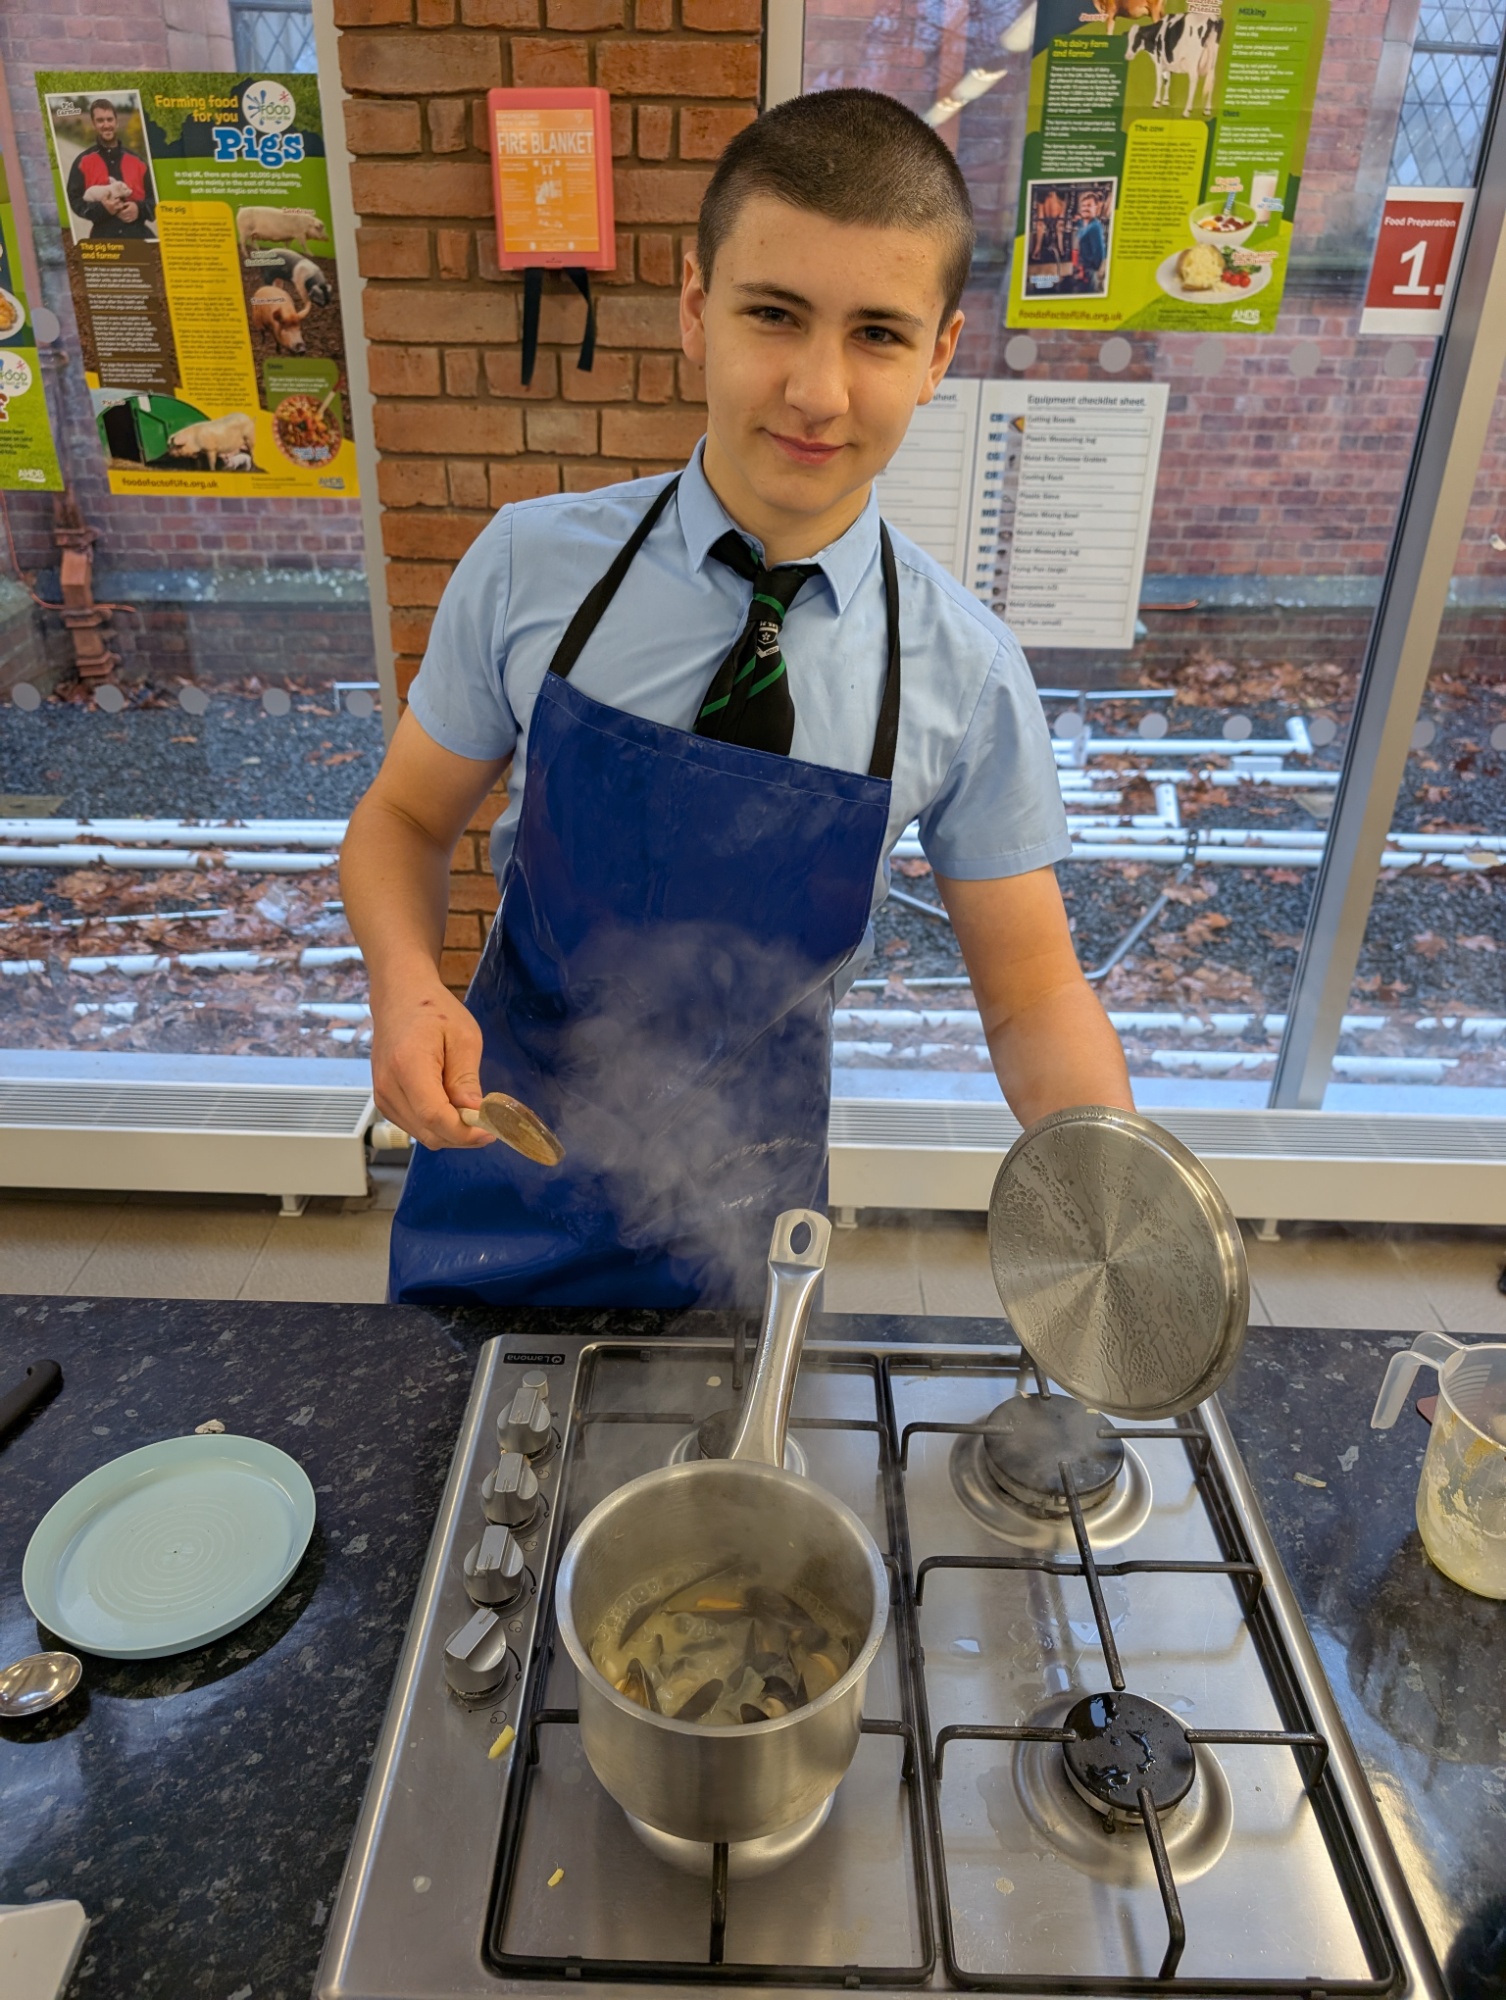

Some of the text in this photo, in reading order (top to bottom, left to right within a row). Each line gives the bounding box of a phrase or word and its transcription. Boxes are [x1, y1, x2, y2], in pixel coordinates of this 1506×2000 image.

[1238, 8, 1267, 18] Milking
[1053, 39, 1110, 50] The dairy farm
[1052, 50, 1095, 58] and farmer
[154, 94, 239, 110] Farming food
[260, 104, 290, 116] FOOD
[193, 109, 239, 125] for you
[1135, 126, 1150, 134] The
[213, 126, 304, 168] Pigs
[498, 132, 594, 154] FIRE BLANKET
[1384, 216, 1456, 228] Food Preparation
[95, 243, 106, 252] pig
[1232, 310, 1260, 322] AHDB
[1028, 395, 1076, 405] Equipment
[1078, 396, 1118, 405] checklist
[506, 1354, 550, 1363] Lamona
